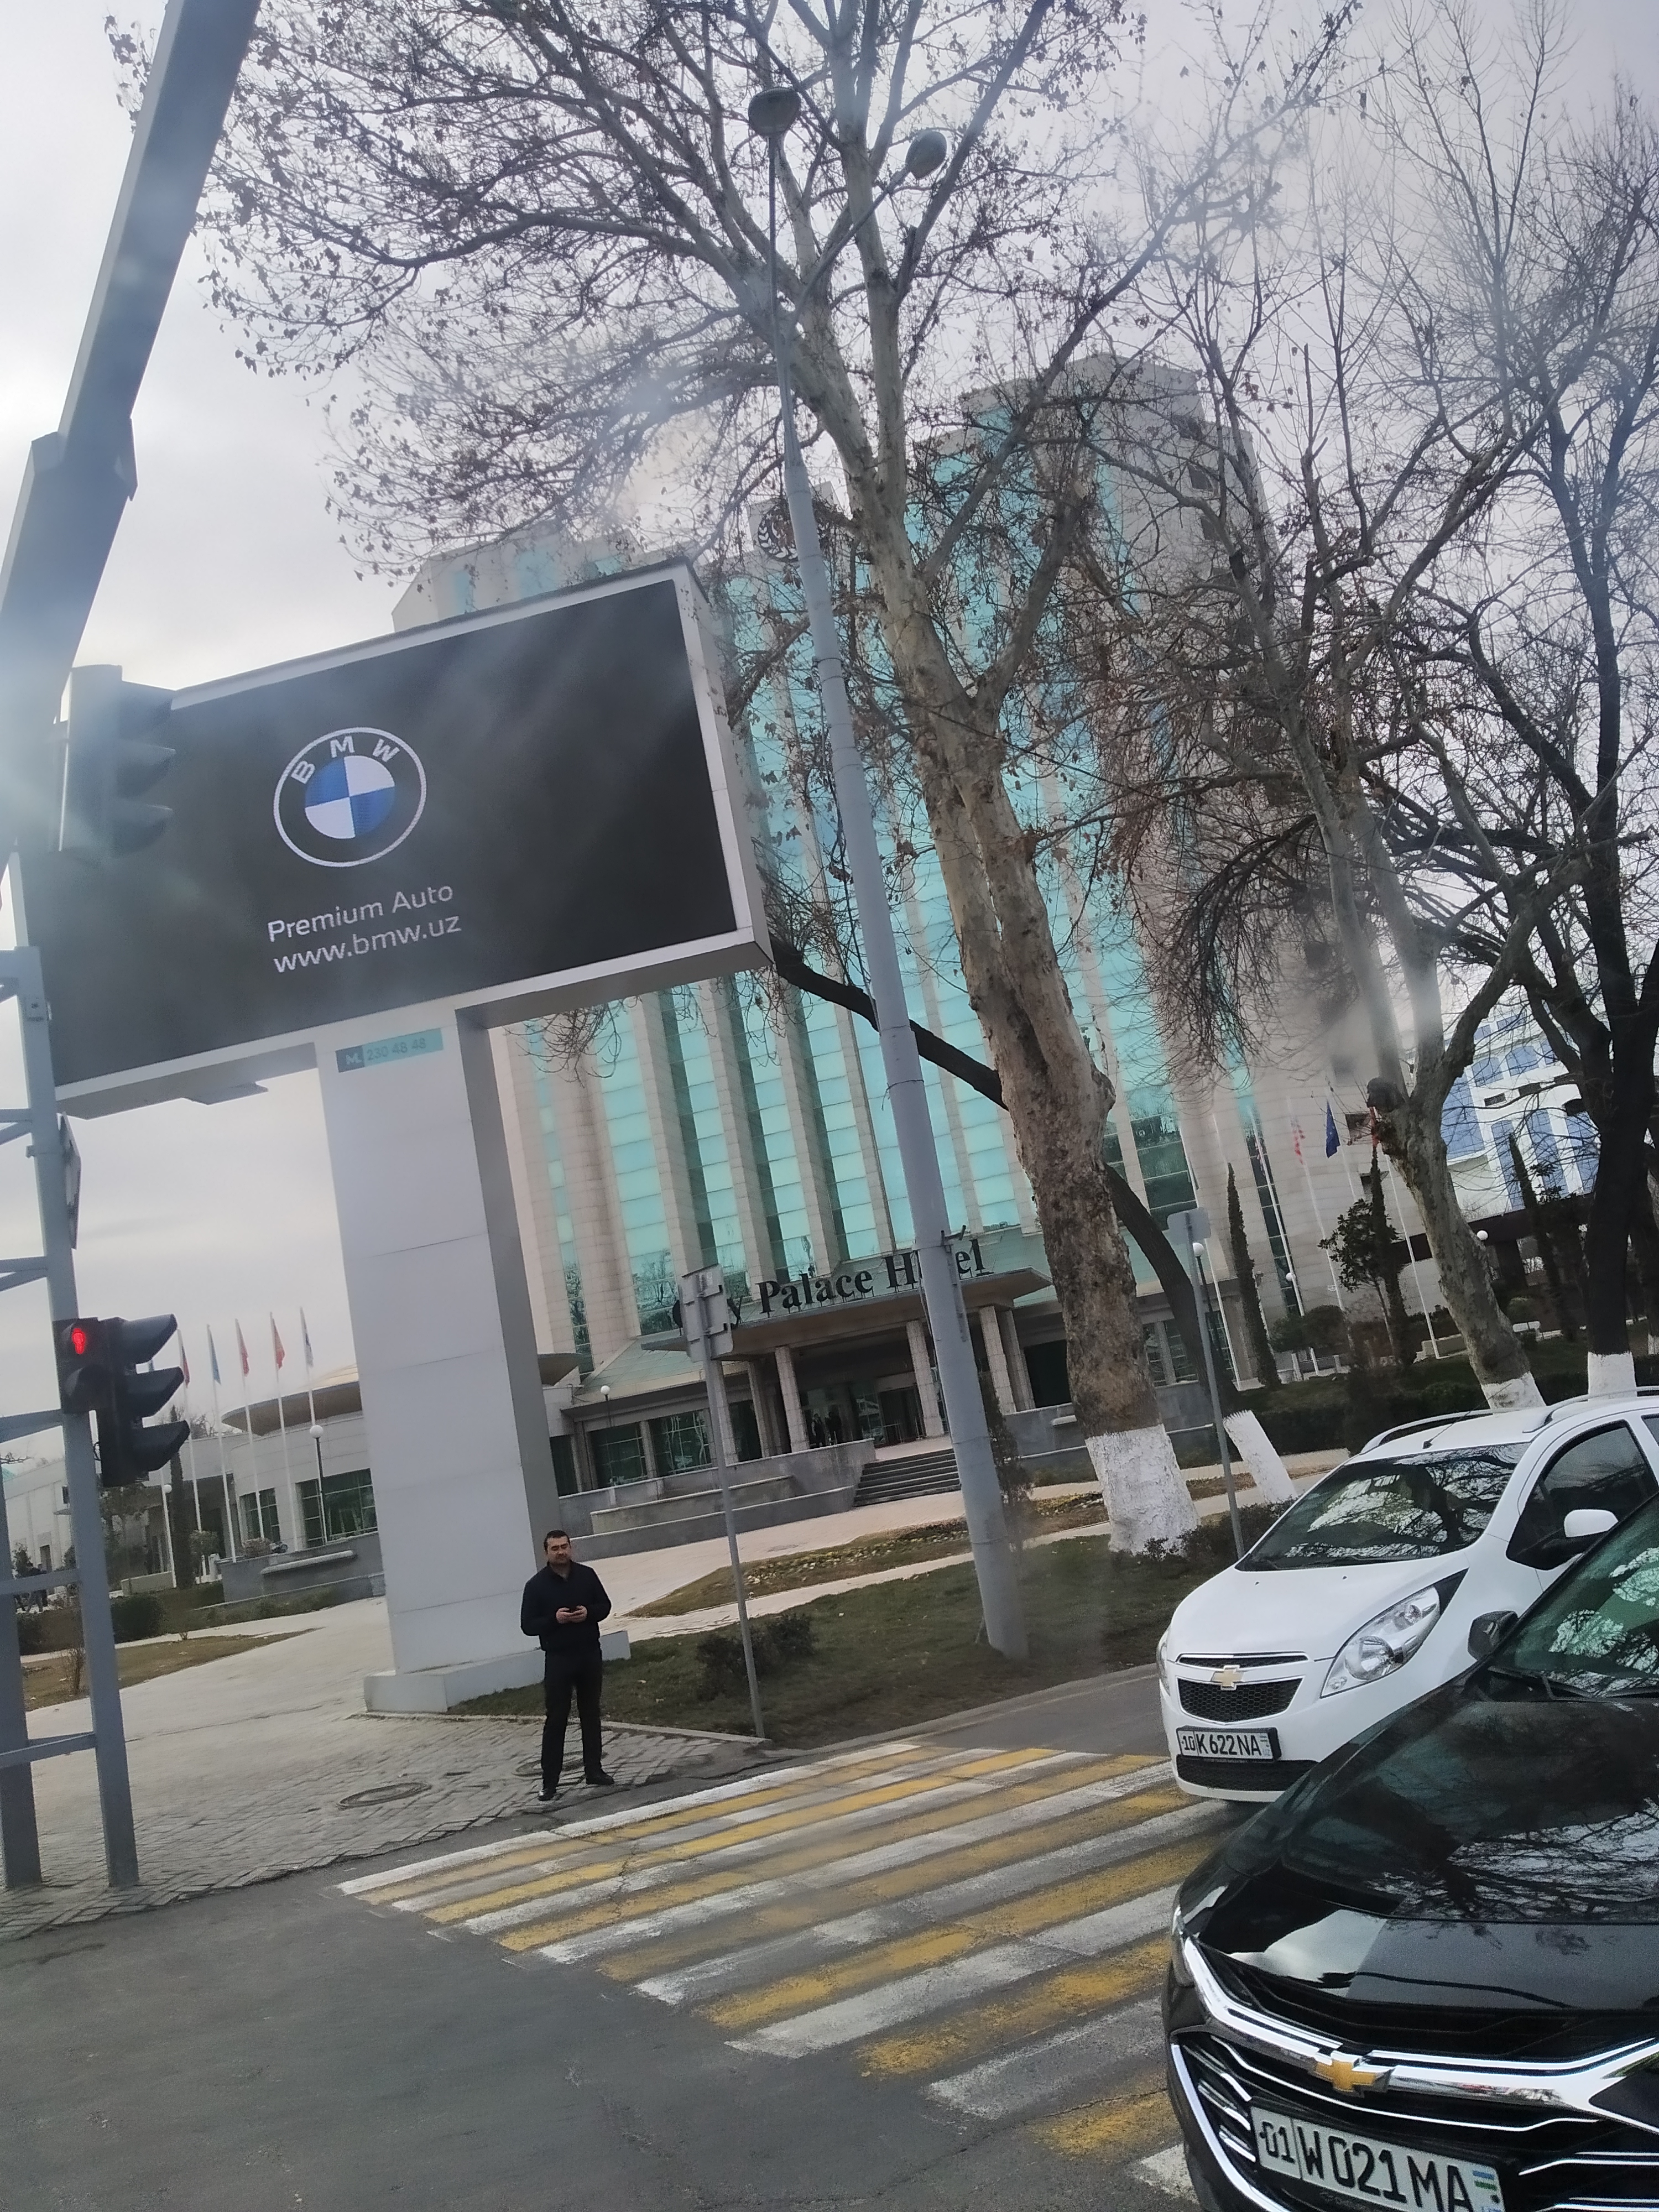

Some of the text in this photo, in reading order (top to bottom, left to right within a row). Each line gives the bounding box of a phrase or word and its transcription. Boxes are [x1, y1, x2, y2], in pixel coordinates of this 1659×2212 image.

[291, 735, 400, 784] BMW
[268, 886, 453, 942] Premium Auto
[273, 915, 462, 973] www.bmw.uz
[755, 1270, 873, 1314] Palace
[883, 1238, 985, 1288] Hel
[1262, 2121, 1295, 2163] 01
